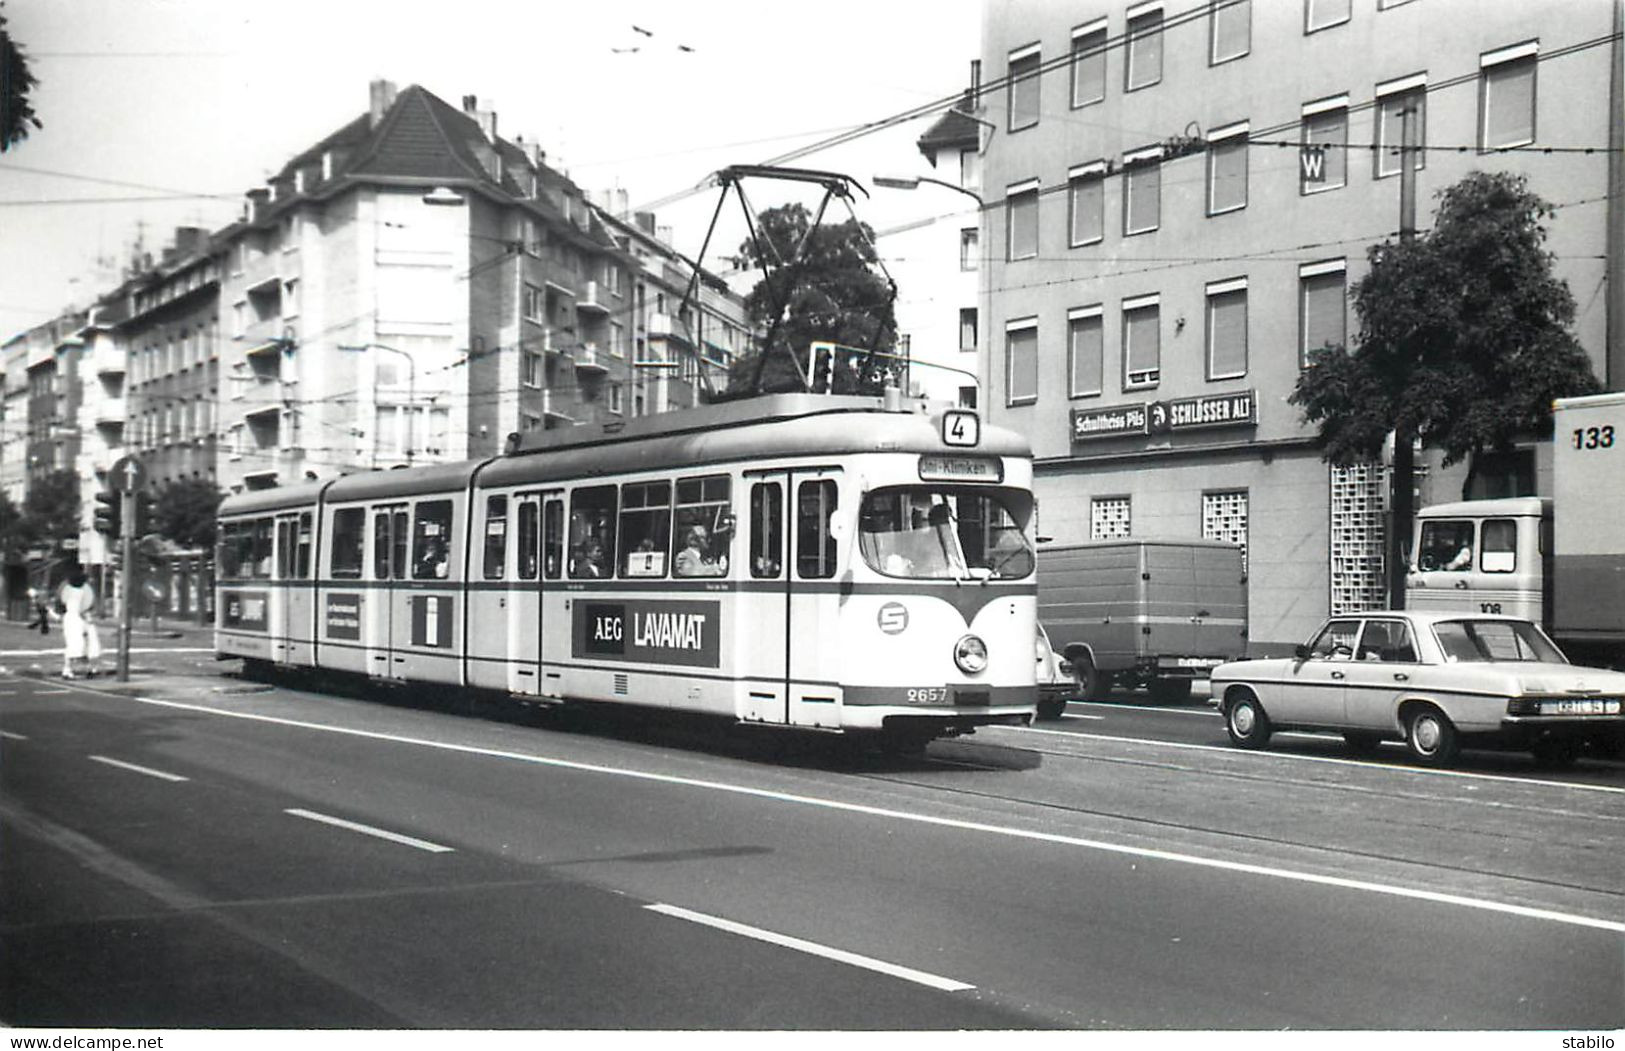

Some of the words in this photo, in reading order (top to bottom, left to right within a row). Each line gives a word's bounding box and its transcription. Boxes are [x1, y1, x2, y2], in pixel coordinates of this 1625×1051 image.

[1302, 153, 1322, 178] W
[1076, 412, 1125, 432] Schultheiss
[1127, 410, 1145, 428] Pils
[1171, 399, 1230, 425] SCHLÖSSER
[1233, 398, 1250, 418] ALT
[951, 416, 964, 440] 4
[1573, 425, 1615, 450] 133
[595, 617, 622, 640] AEG
[634, 613, 705, 650] LAVAMAT
[907, 688, 947, 703] 2657
